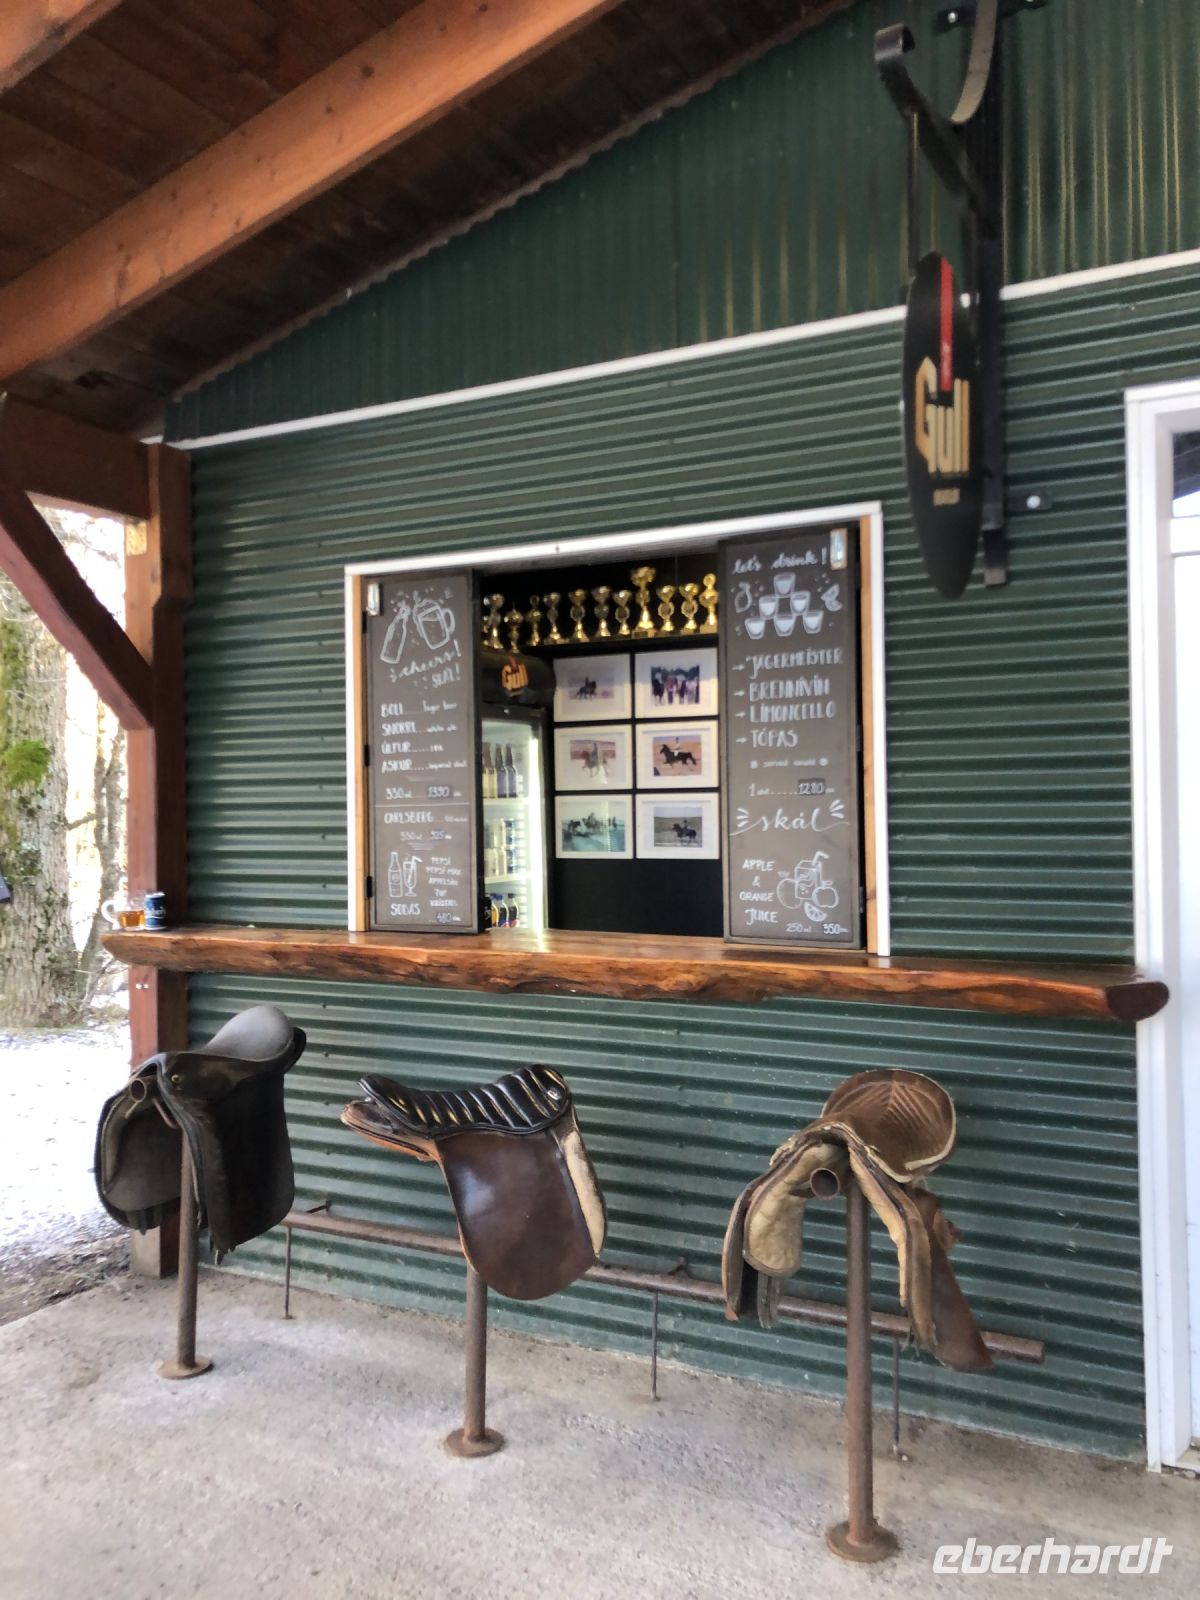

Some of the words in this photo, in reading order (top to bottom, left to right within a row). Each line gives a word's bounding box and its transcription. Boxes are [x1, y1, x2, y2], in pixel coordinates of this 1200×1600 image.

[915, 356, 970, 474] Gull
[742, 859, 775, 871] APPLE
[744, 908, 778, 925] JUICE
